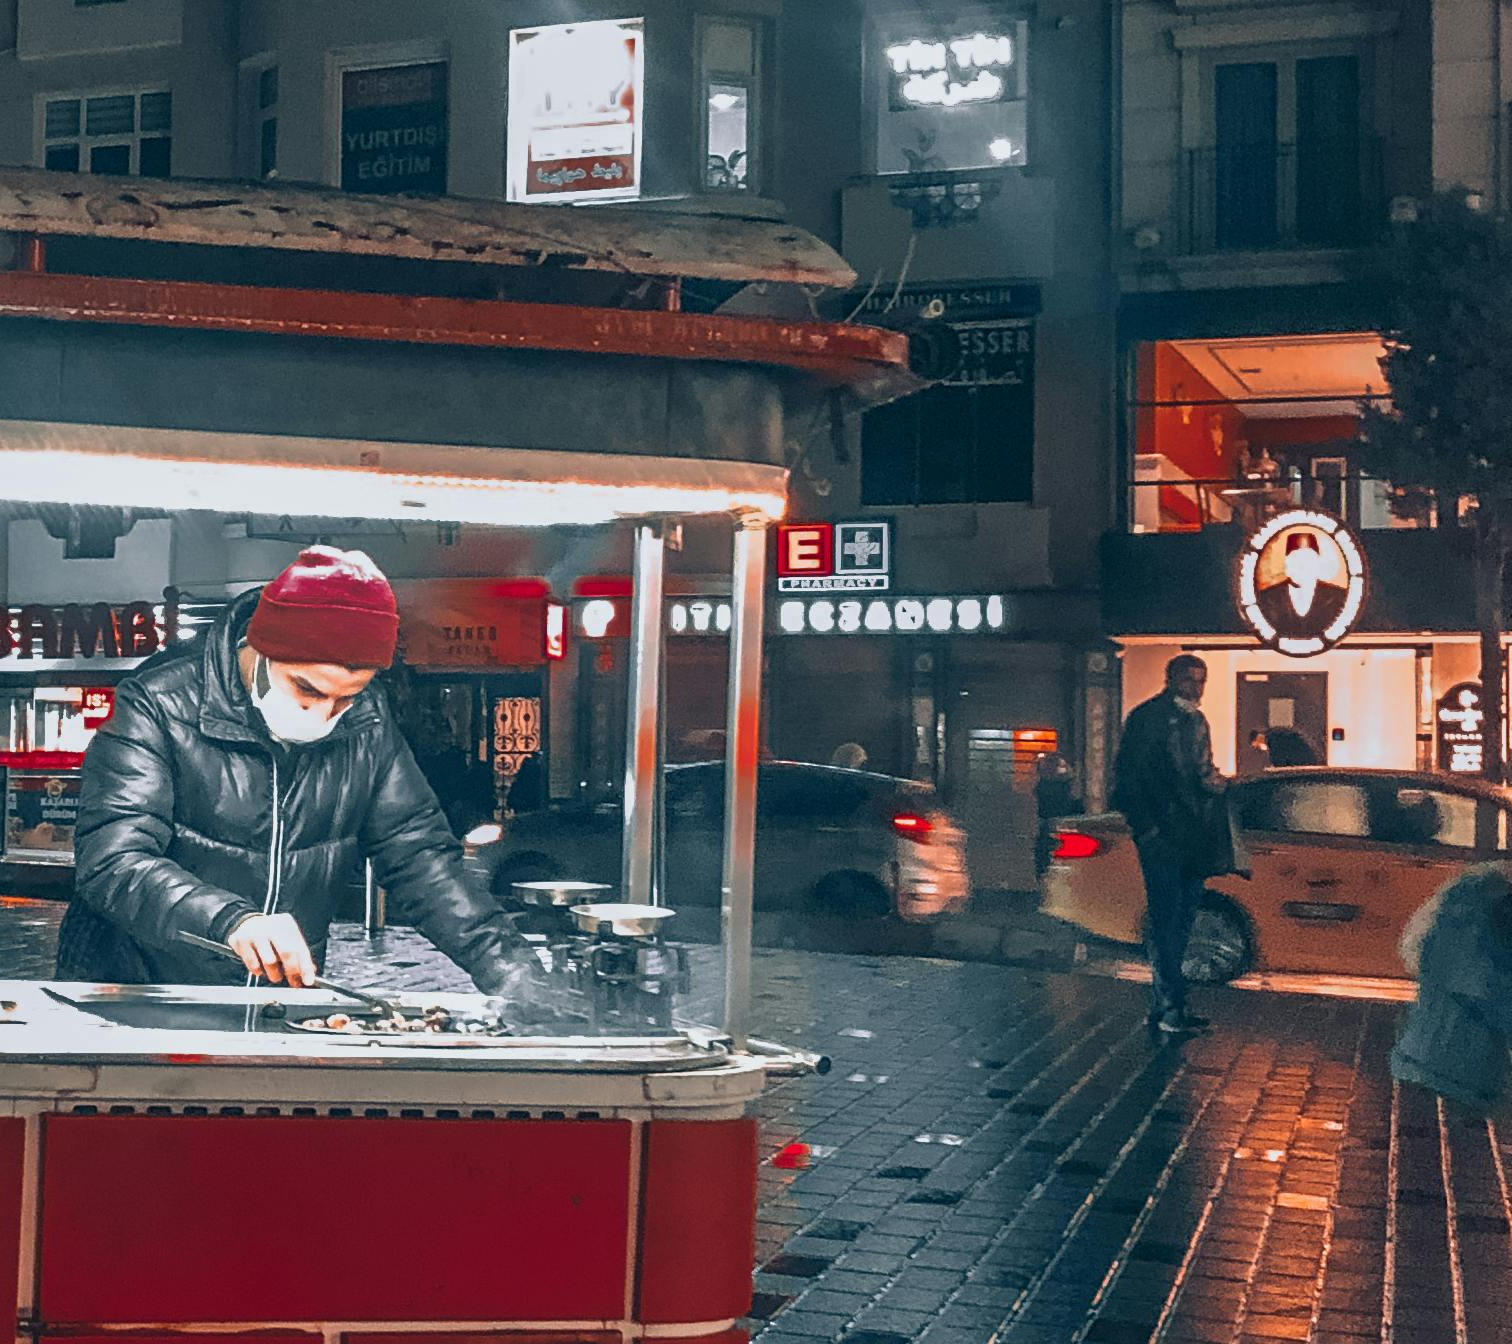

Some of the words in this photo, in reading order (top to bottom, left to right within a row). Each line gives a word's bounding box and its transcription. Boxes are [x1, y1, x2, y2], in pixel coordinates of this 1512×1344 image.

[357, 152, 431, 180] EĞİTİM
[788, 531, 821, 570] E
[790, 578, 878, 589] PHARMACY
